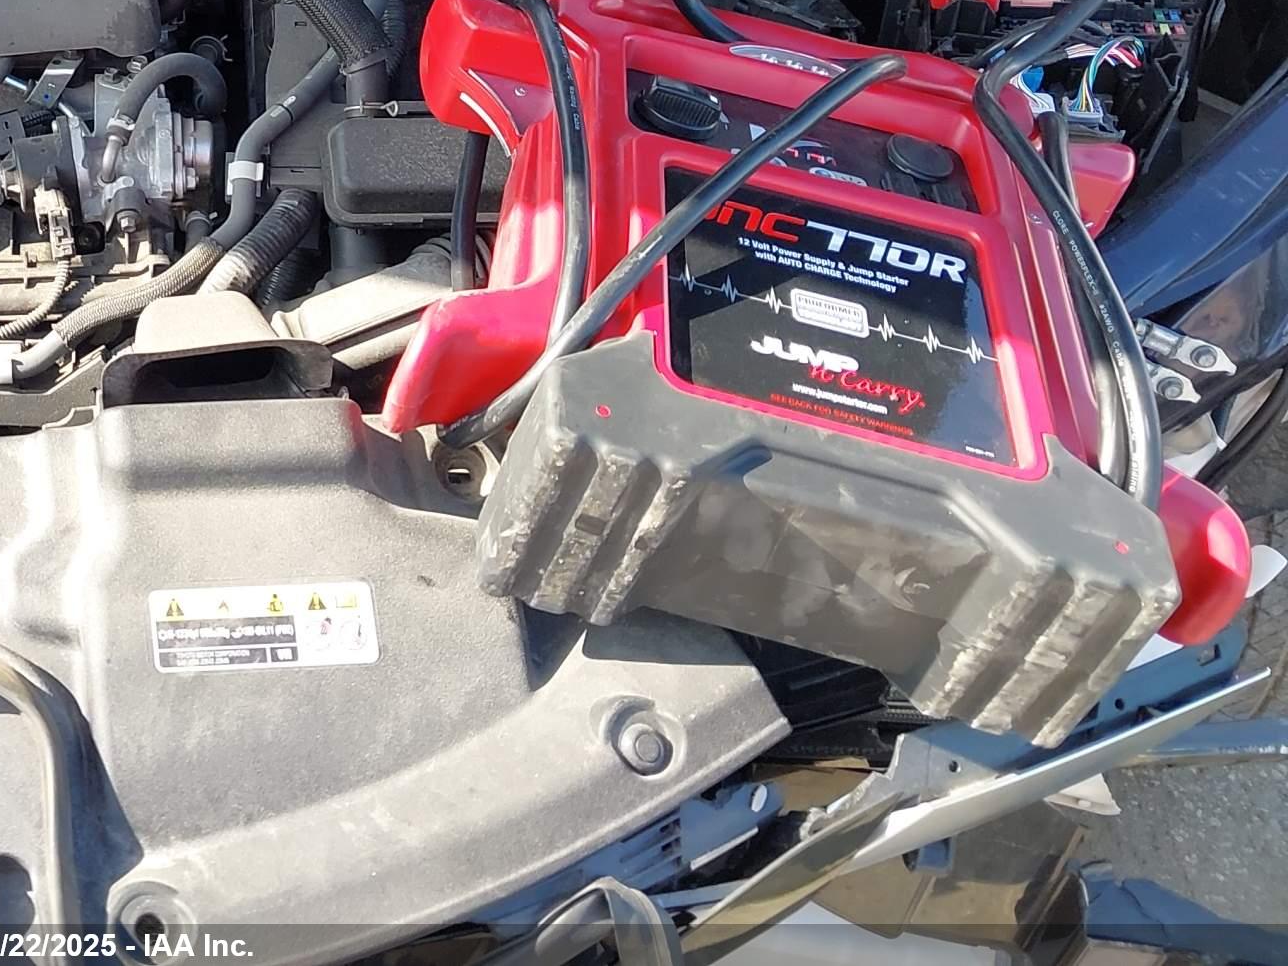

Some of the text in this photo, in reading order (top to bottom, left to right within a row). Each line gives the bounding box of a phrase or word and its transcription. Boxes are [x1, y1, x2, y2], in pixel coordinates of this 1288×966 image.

[1052, 210, 1069, 235] CLORE
[738, 237, 910, 286] 12 Volt Power Supply & Jump Starter
[755, 250, 897, 293] with AUTO CHARGE Technology
[750, 335, 859, 373] JUMP
